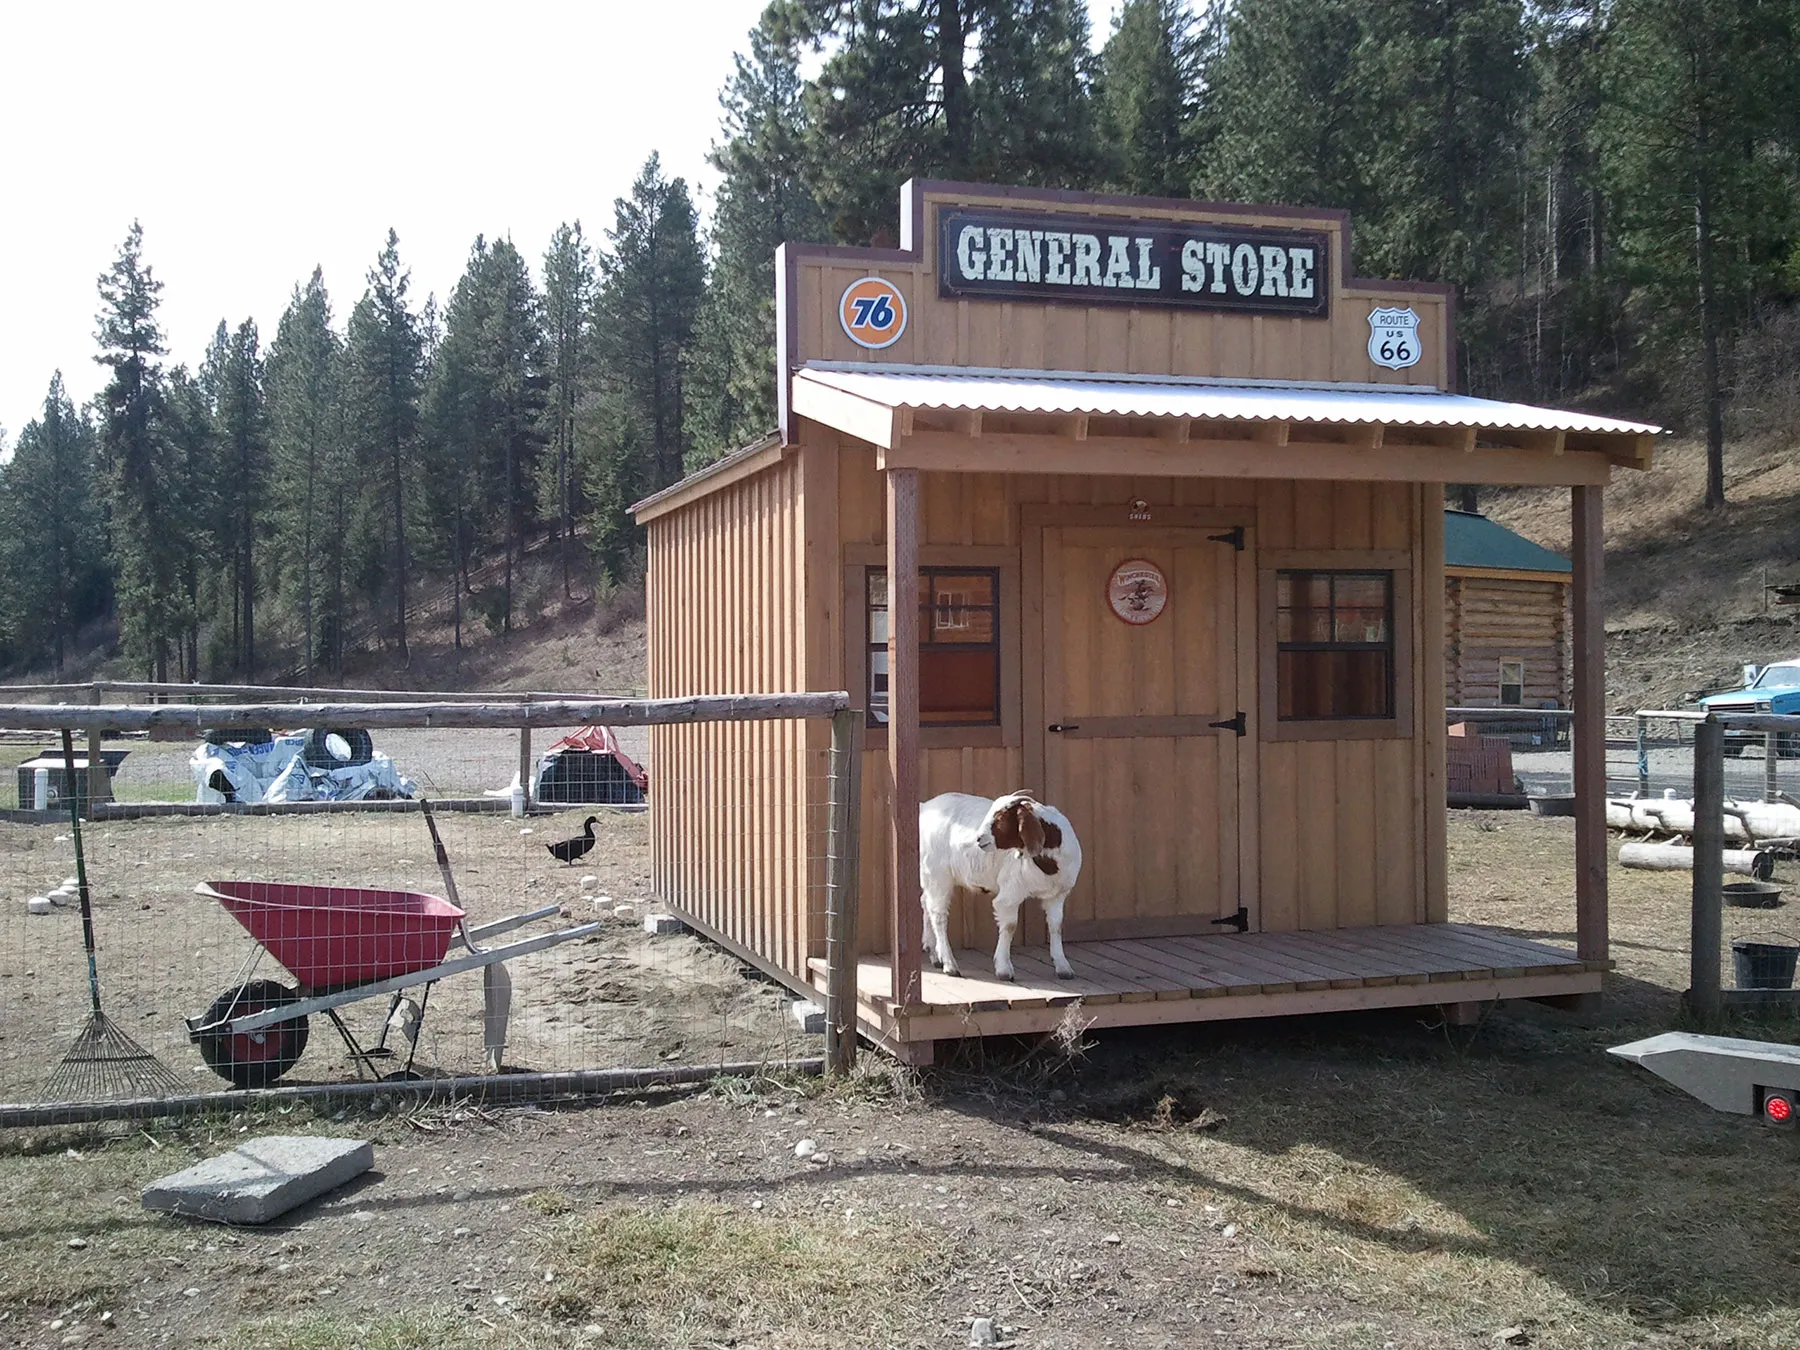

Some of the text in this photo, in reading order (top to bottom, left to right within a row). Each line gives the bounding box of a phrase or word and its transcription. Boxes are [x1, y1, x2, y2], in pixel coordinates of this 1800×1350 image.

[957, 225, 1315, 299] GENERAL STORE
[850, 293, 896, 331] 76
[1379, 315, 1409, 326] ROUTE
[1380, 340, 1411, 361] 66
